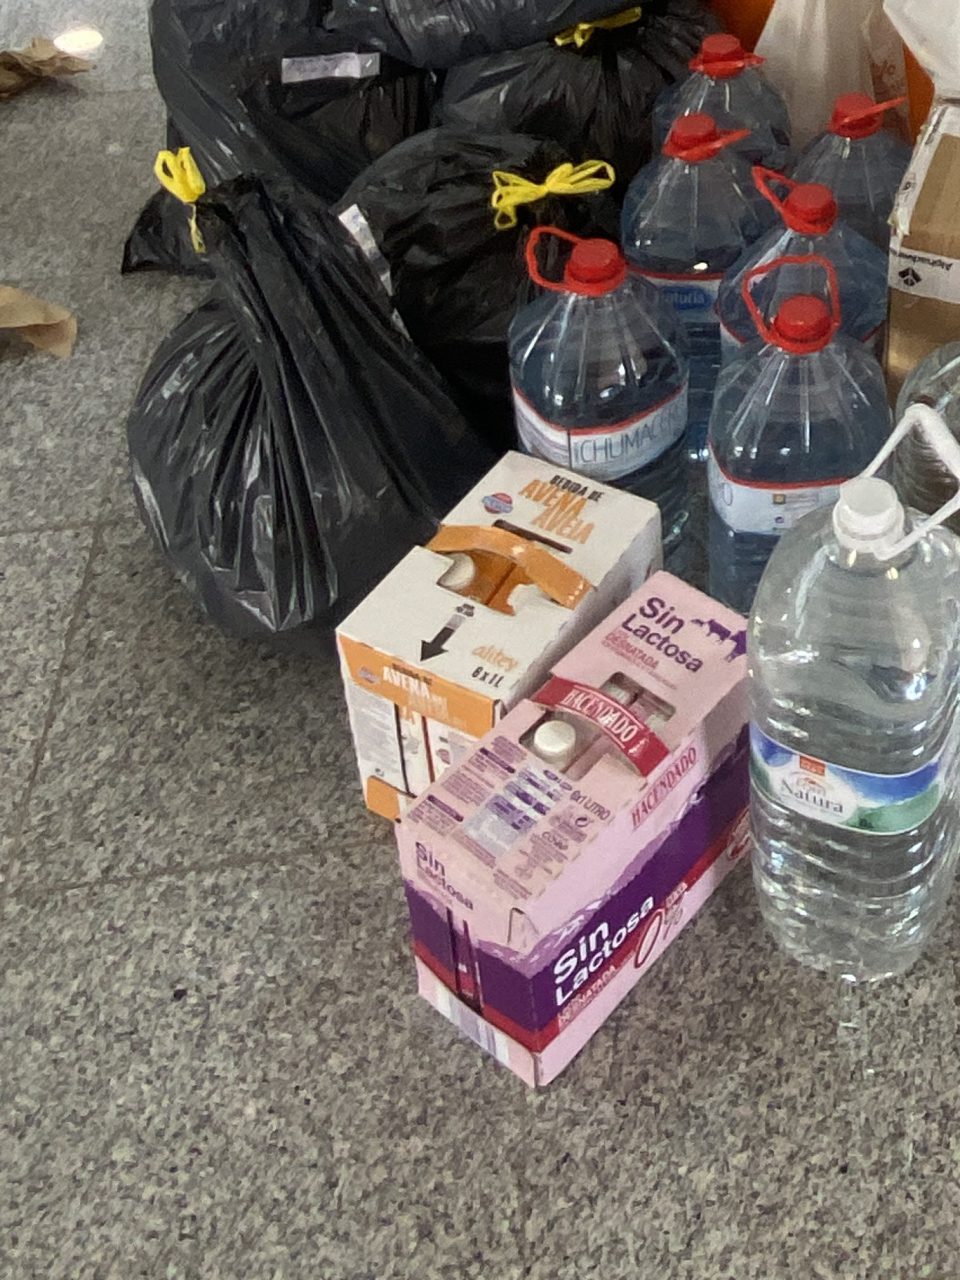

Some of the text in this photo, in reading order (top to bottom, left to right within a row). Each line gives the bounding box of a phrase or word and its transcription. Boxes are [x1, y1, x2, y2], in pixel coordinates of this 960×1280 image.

[518, 479, 588, 517] AVENA
[621, 613, 704, 673] Lactosa
[639, 596, 686, 635] Sin
[560, 688, 640, 744] HACENDADO
[630, 746, 697, 832] HACENDADO
[781, 778, 845, 814] Natura
[415, 841, 446, 877] Sin
[416, 854, 475, 911] Lactosa
[553, 920, 610, 985] Sin
[555, 896, 655, 1007] Lactosa
